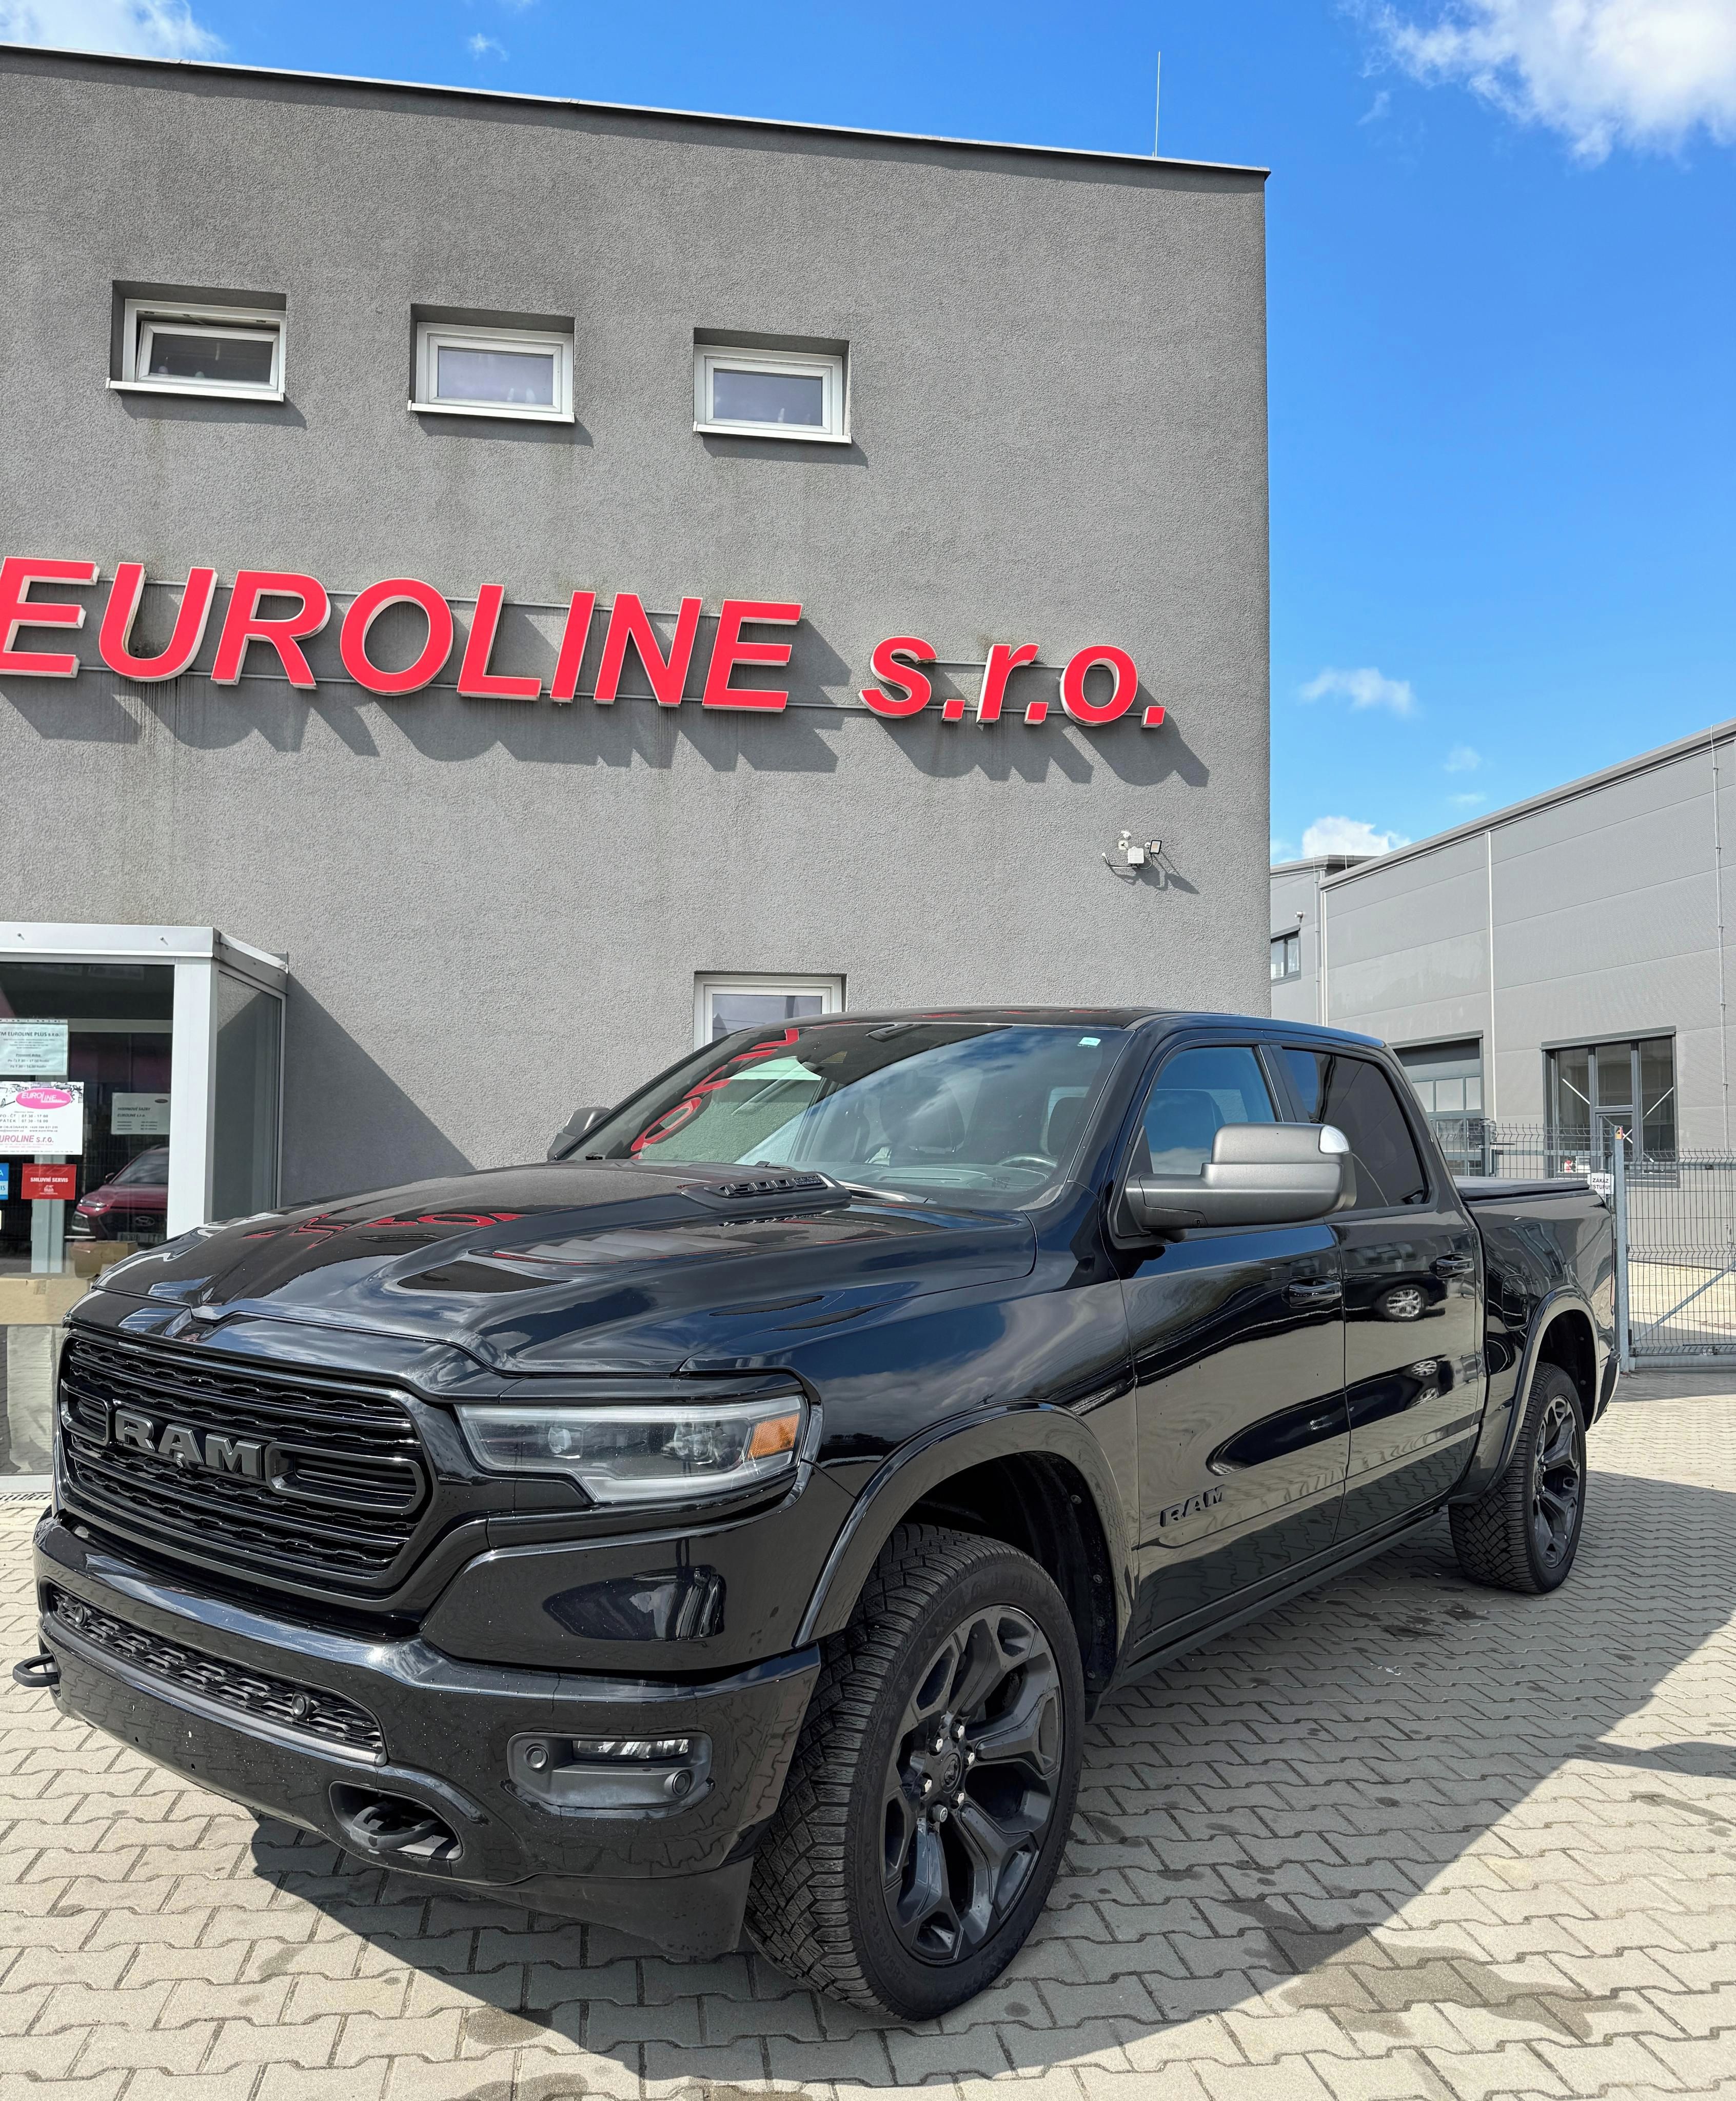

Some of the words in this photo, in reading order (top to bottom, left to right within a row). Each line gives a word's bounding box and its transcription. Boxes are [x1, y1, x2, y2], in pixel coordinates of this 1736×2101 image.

[0, 556, 802, 712] EUROLINE
[858, 635, 1166, 728] s.r.o.
[719, 1179, 794, 1196] 1500
[115, 1409, 263, 1479] RAM
[1160, 1484, 1228, 1527] RAM
